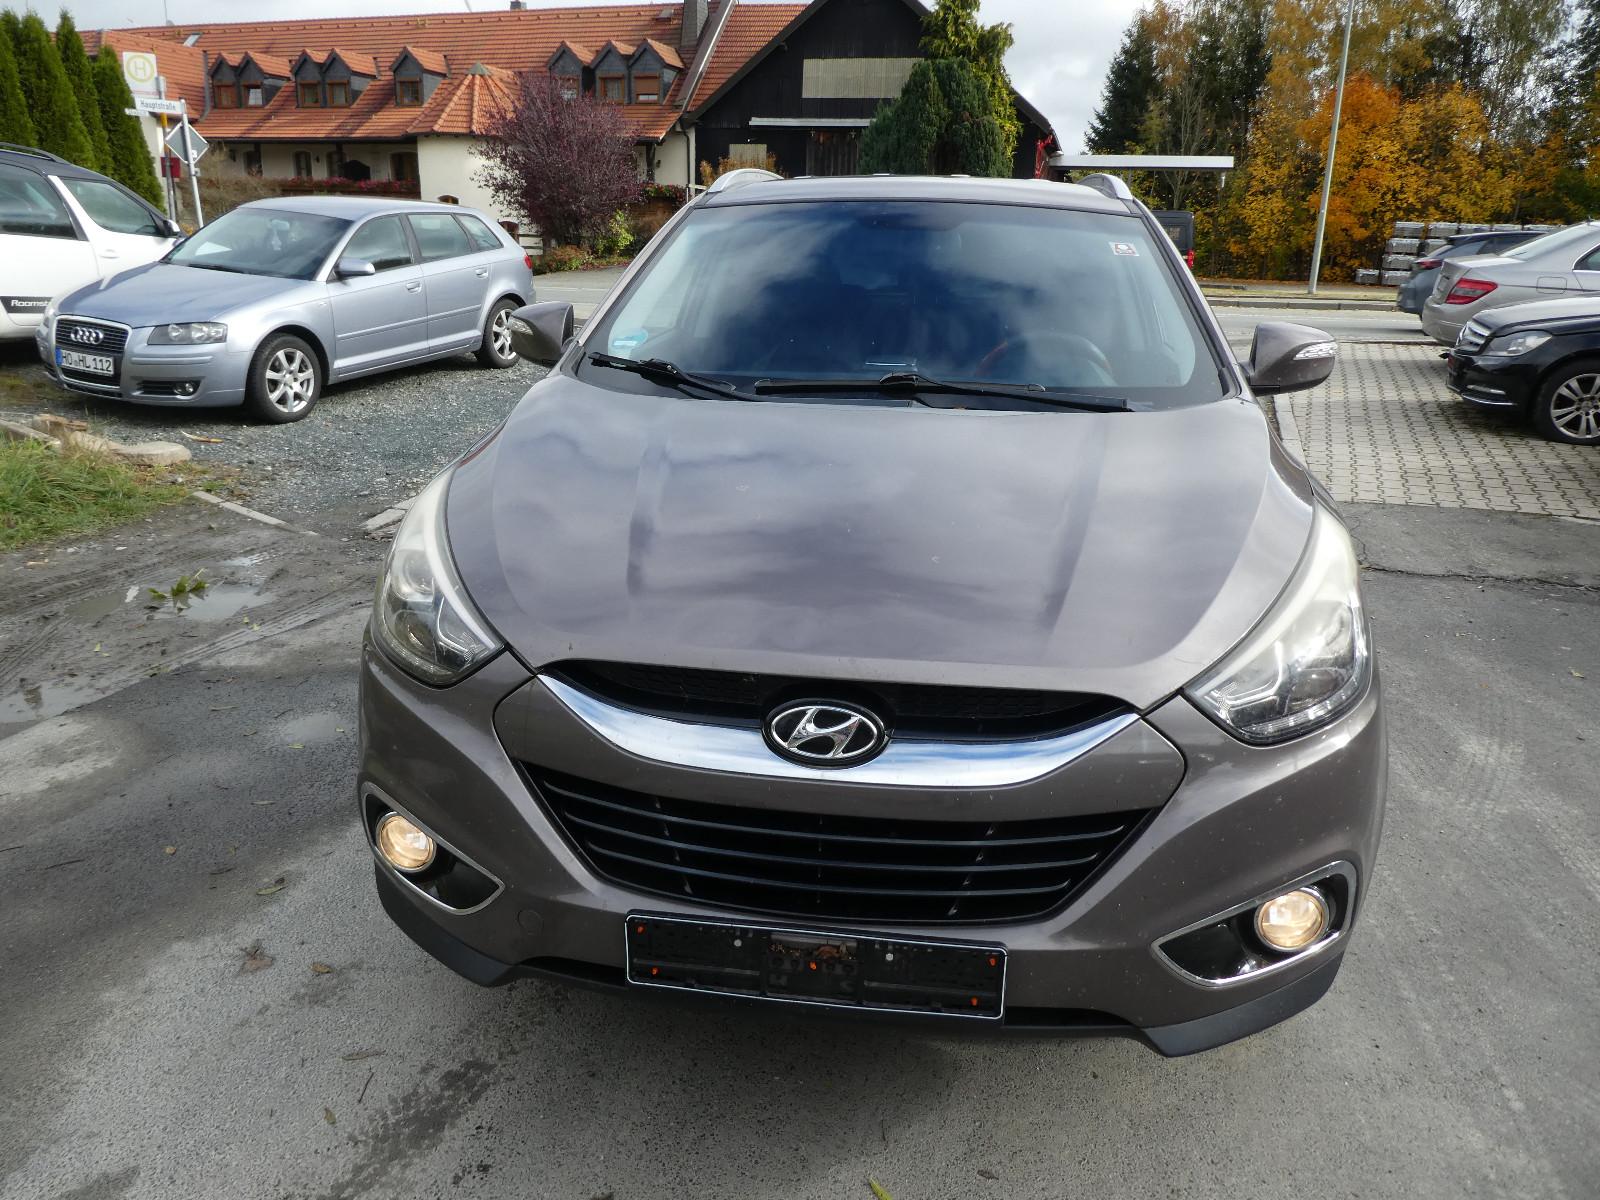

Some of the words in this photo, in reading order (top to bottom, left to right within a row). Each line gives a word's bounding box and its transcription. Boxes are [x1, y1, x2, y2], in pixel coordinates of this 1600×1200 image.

[140, 99, 176, 111] Hauptstraße
[78, 354, 91, 369] HL
[92, 357, 112, 373] 112
